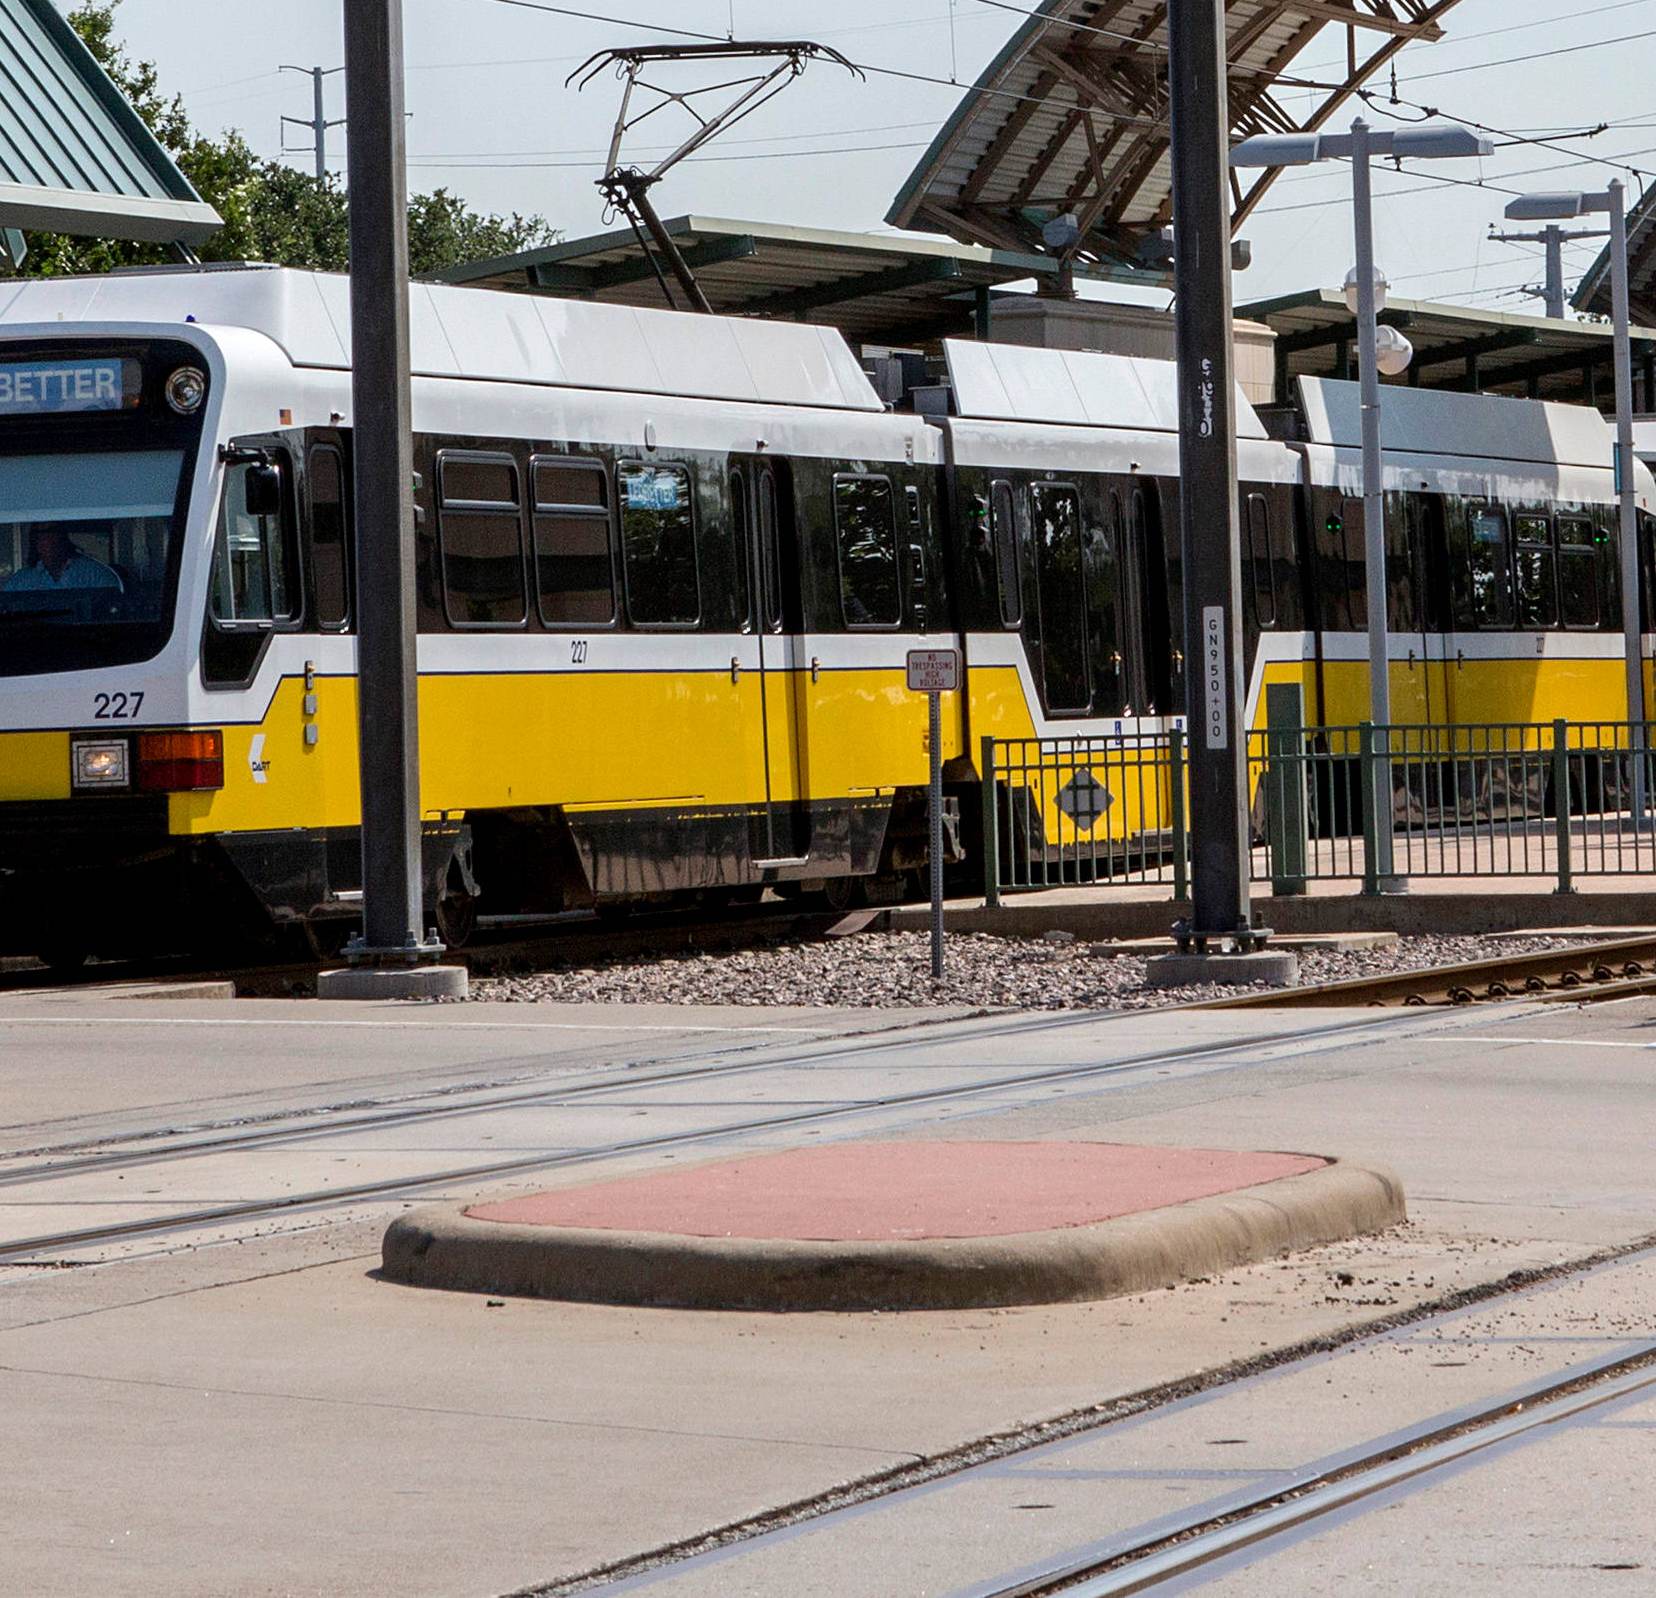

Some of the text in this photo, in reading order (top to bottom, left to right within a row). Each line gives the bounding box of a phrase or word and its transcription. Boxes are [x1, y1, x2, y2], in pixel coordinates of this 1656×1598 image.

[571, 640, 588, 664] 227
[1209, 619, 1221, 737] GN950+00
[94, 692, 144, 719] 227
[252, 761, 271, 772] DART
